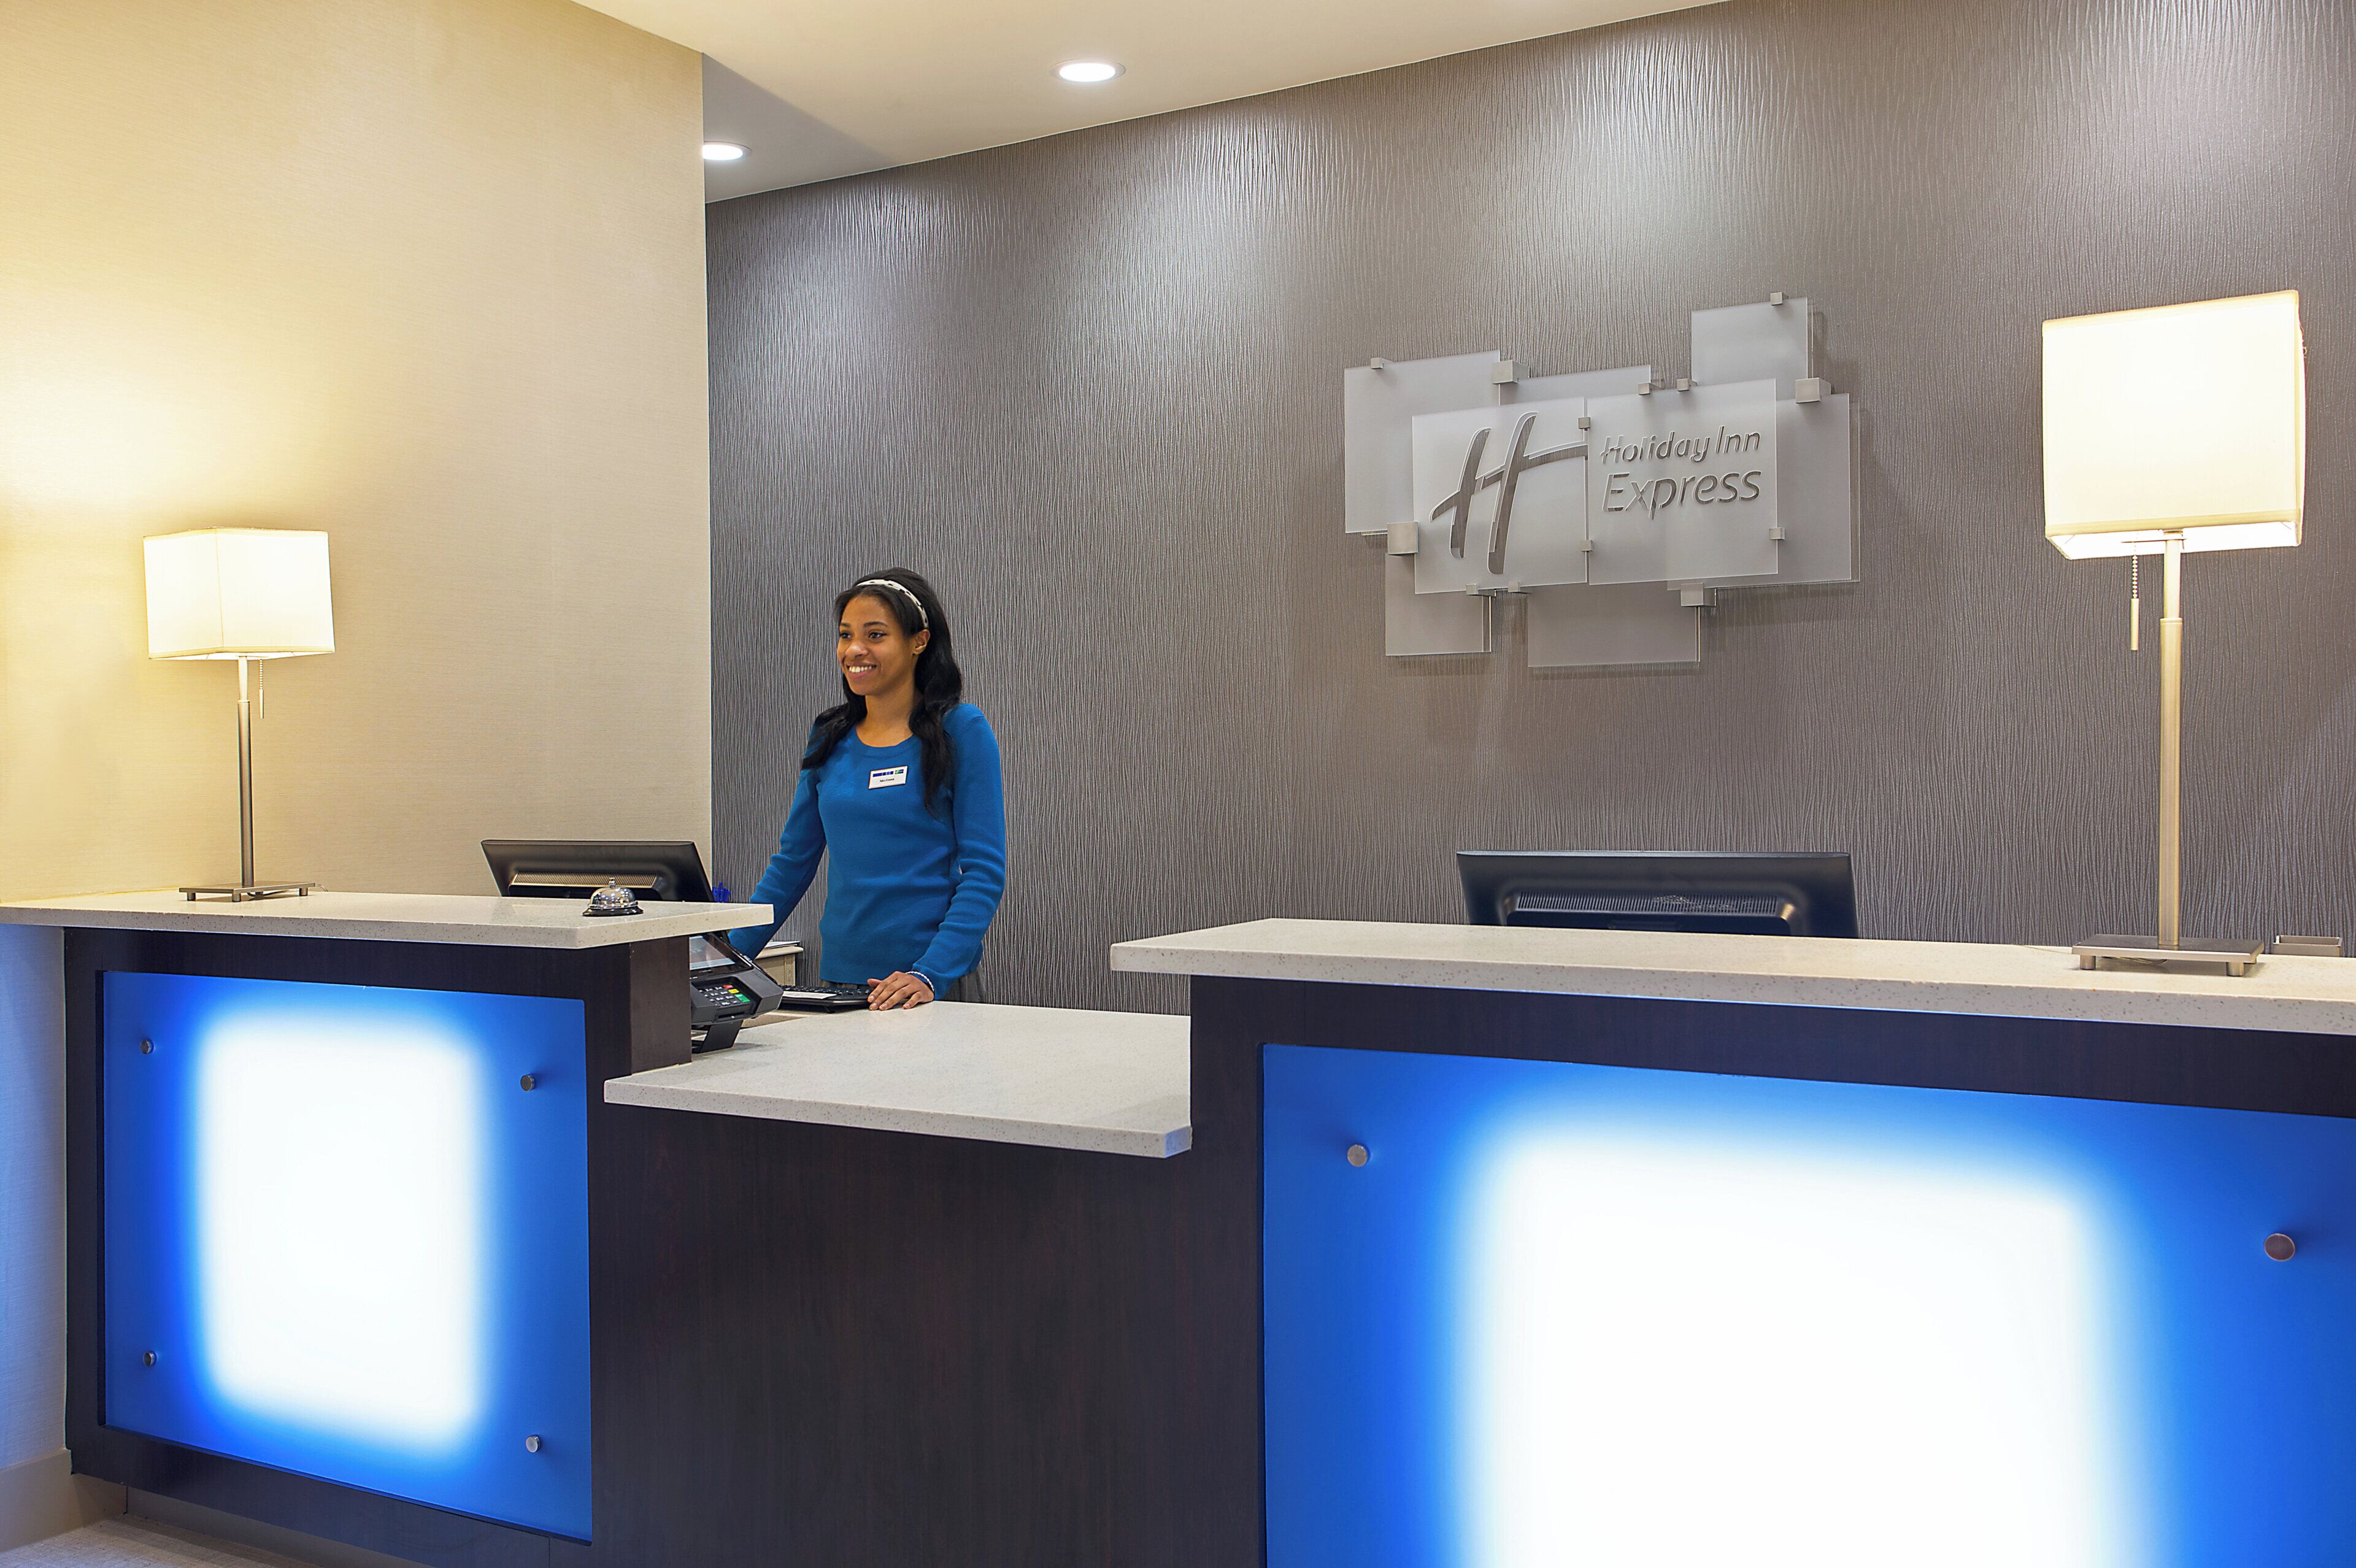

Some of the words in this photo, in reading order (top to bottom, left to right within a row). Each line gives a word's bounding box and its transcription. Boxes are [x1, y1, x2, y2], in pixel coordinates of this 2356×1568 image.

[1600, 431, 1711, 464] Holiday
[1715, 425, 1761, 455] Inn
[1602, 470, 1762, 520] Express
